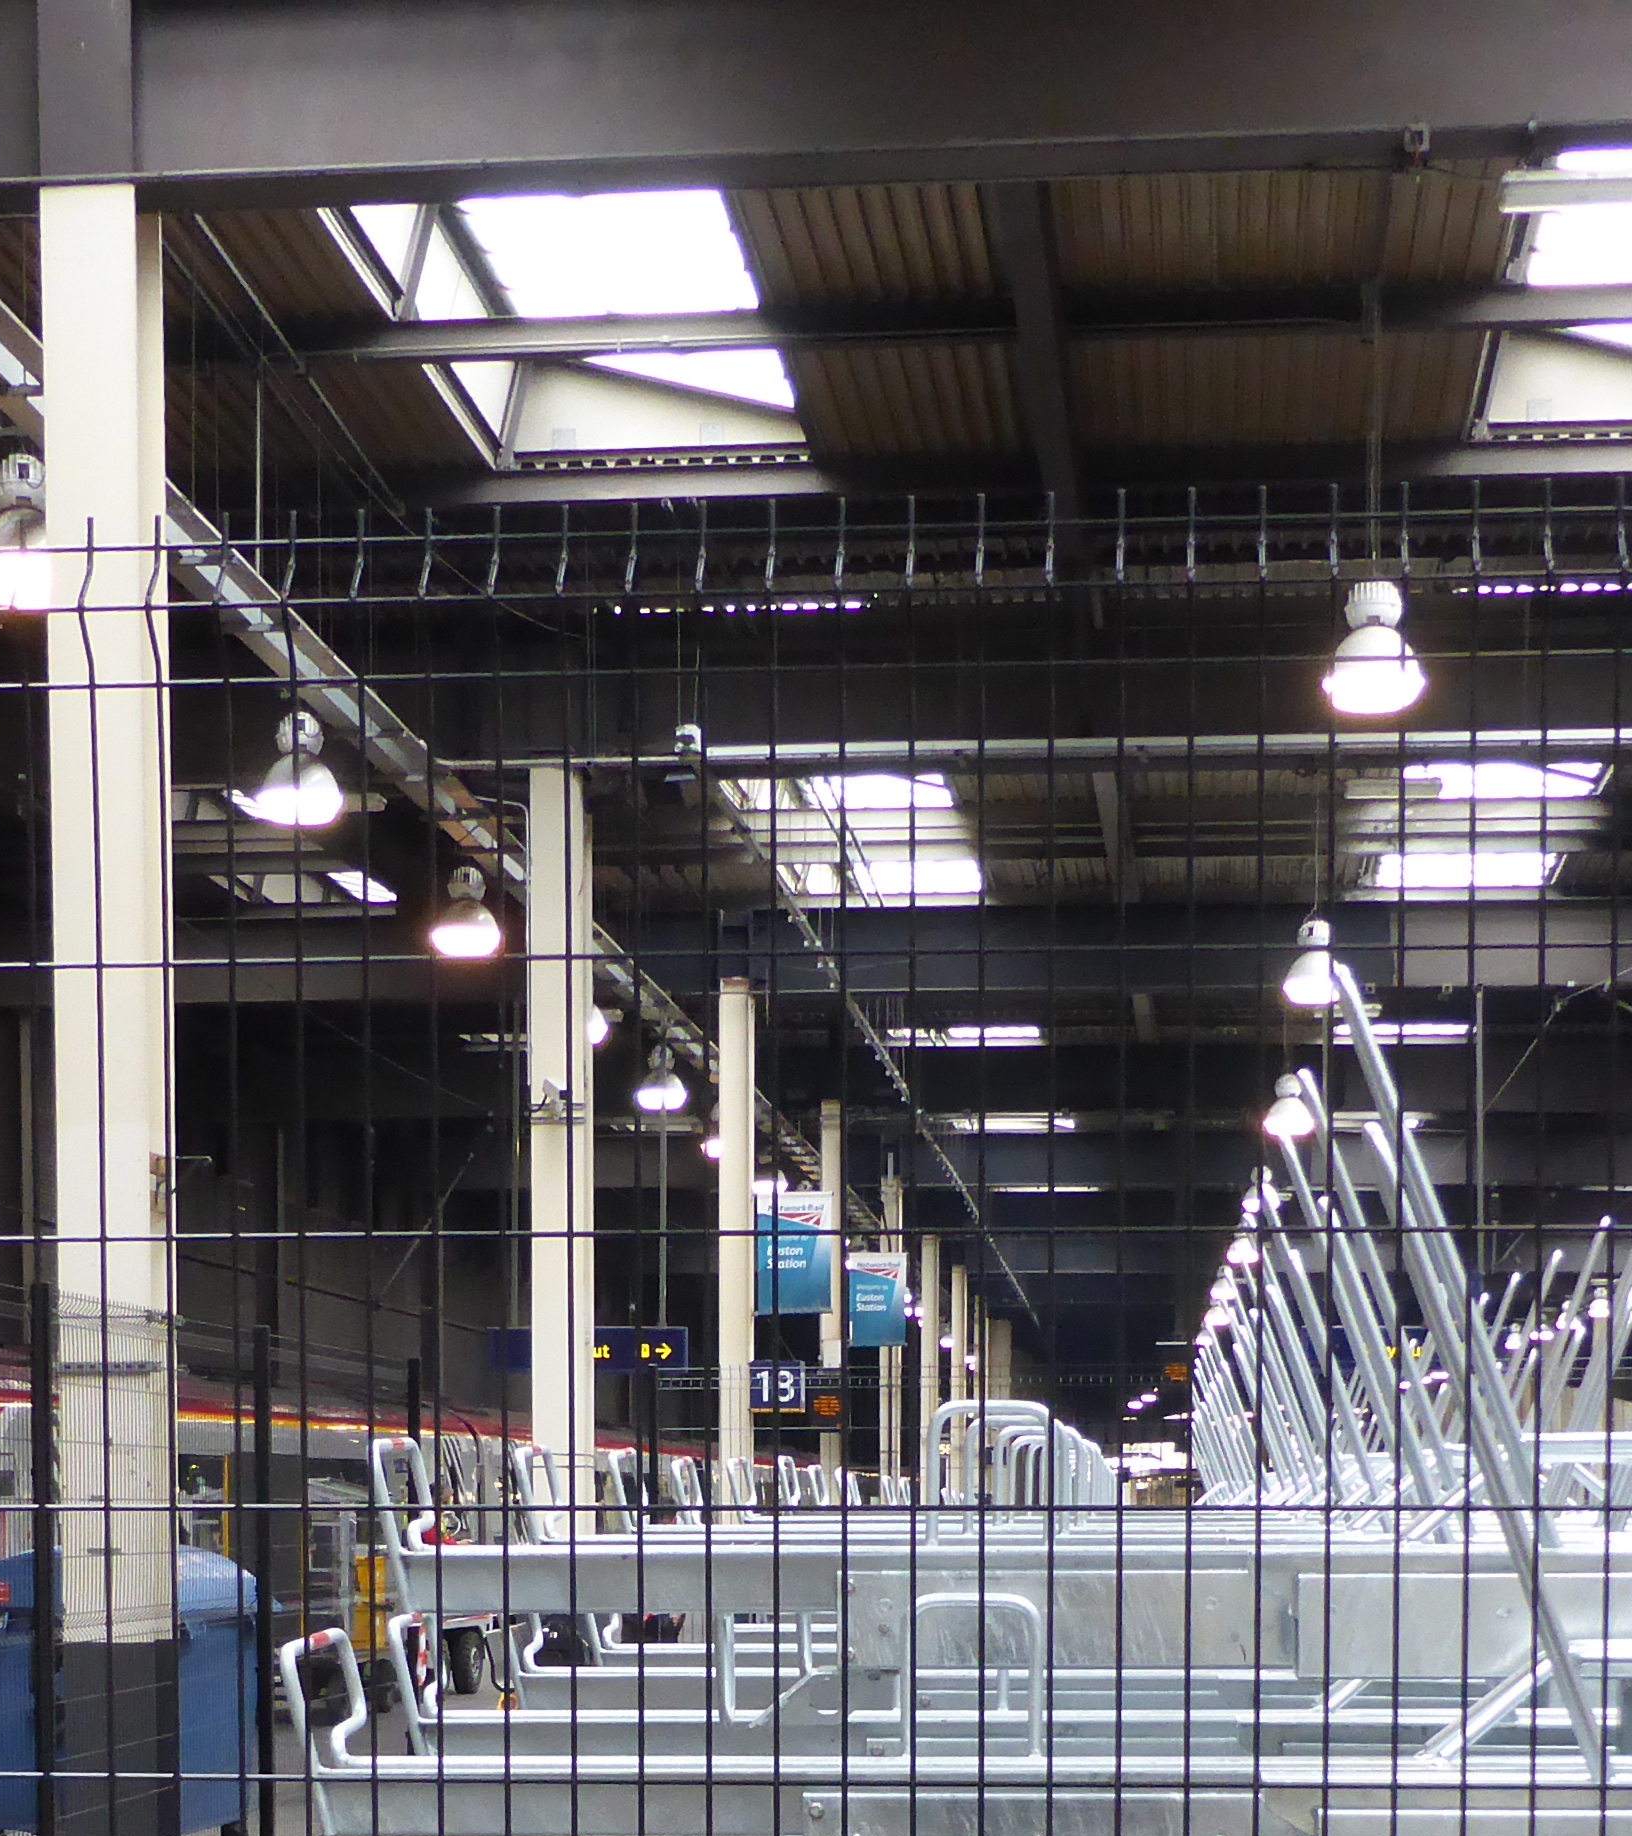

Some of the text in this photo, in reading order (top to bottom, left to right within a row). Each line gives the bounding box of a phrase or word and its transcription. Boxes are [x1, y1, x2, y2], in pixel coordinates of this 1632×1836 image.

[766, 1245, 804, 1256] Eston
[766, 1258, 807, 1269] Sation
[856, 1293, 885, 1302] Euston
[856, 1303, 887, 1312] Station
[593, 1344, 611, 1359] ut
